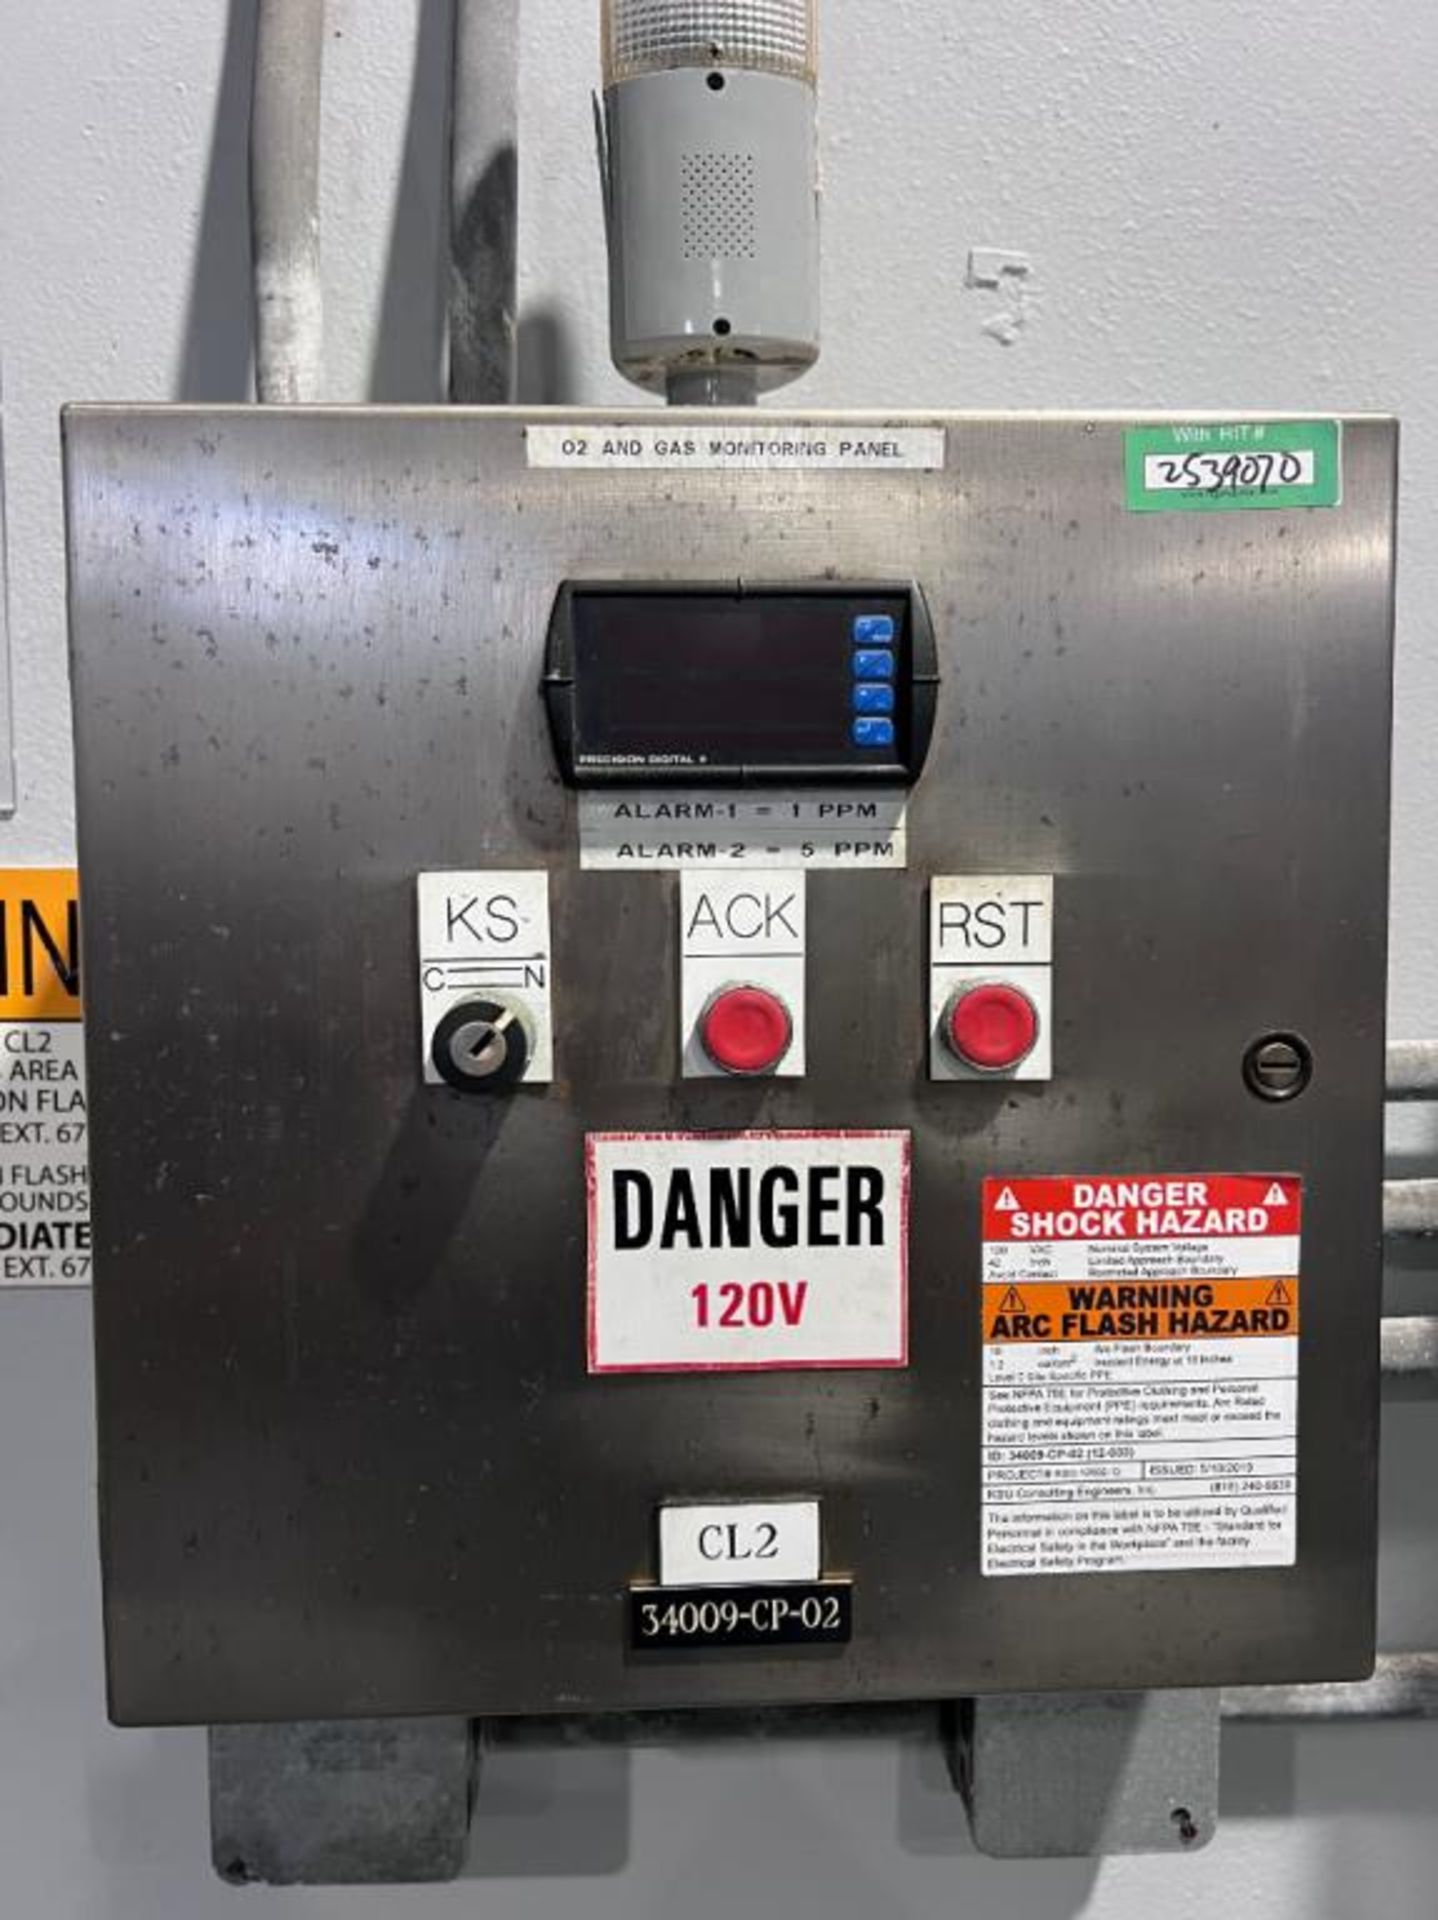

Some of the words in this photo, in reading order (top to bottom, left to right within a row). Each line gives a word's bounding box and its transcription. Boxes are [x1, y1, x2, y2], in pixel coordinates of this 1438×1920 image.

[602, 440, 641, 455] AND
[655, 440, 695, 455] GAS
[709, 440, 826, 456] MONITORING
[839, 441, 902, 457] PANEL
[1158, 452, 1301, 494] 2539070
[579, 754, 645, 764] PRECISION
[649, 754, 693, 764] DIGITAL
[614, 803, 737, 818] ALARM-1
[793, 803, 799, 818] 1
[819, 803, 877, 818] PPM
[617, 843, 746, 858] ALARM-2
[802, 843, 814, 858] 5
[835, 842, 894, 857] PPM
[446, 896, 519, 943] KS
[687, 894, 799, 939] ACK
[938, 902, 1045, 949] RST
[423, 967, 445, 991] C
[524, 965, 545, 989] N
[4, 1030, 52, 1053] CL2
[9, 1060, 78, 1082] AREA
[0, 1089, 28, 1112] N
[37, 1089, 86, 1112] FLA
[0, 1122, 49, 1143] EXT.
[56, 1122, 86, 1143] 67
[11, 1165, 87, 1186] FLASH
[0, 1191, 88, 1213] OUNDS
[613, 1165, 884, 1250] DANGER
[1074, 1182, 1207, 1208] DANGER
[1011, 1211, 1125, 1236] SHOCK
[1136, 1208, 1268, 1233] HAZARD
[0, 1222, 91, 1250] DIATE
[4, 1257, 54, 1278] EXT.
[61, 1257, 91, 1278] 67
[691, 1281, 808, 1328] 120V
[1067, 1285, 1214, 1311] WARNING
[991, 1314, 1050, 1338] ARC
[1062, 1312, 1158, 1336] FLASH
[1169, 1308, 1289, 1333] HAZARD
[1017, 1487, 1073, 1500] Consulting
[698, 1523, 779, 1560] CL2
[641, 1597, 841, 1635] 34009-CP-02
